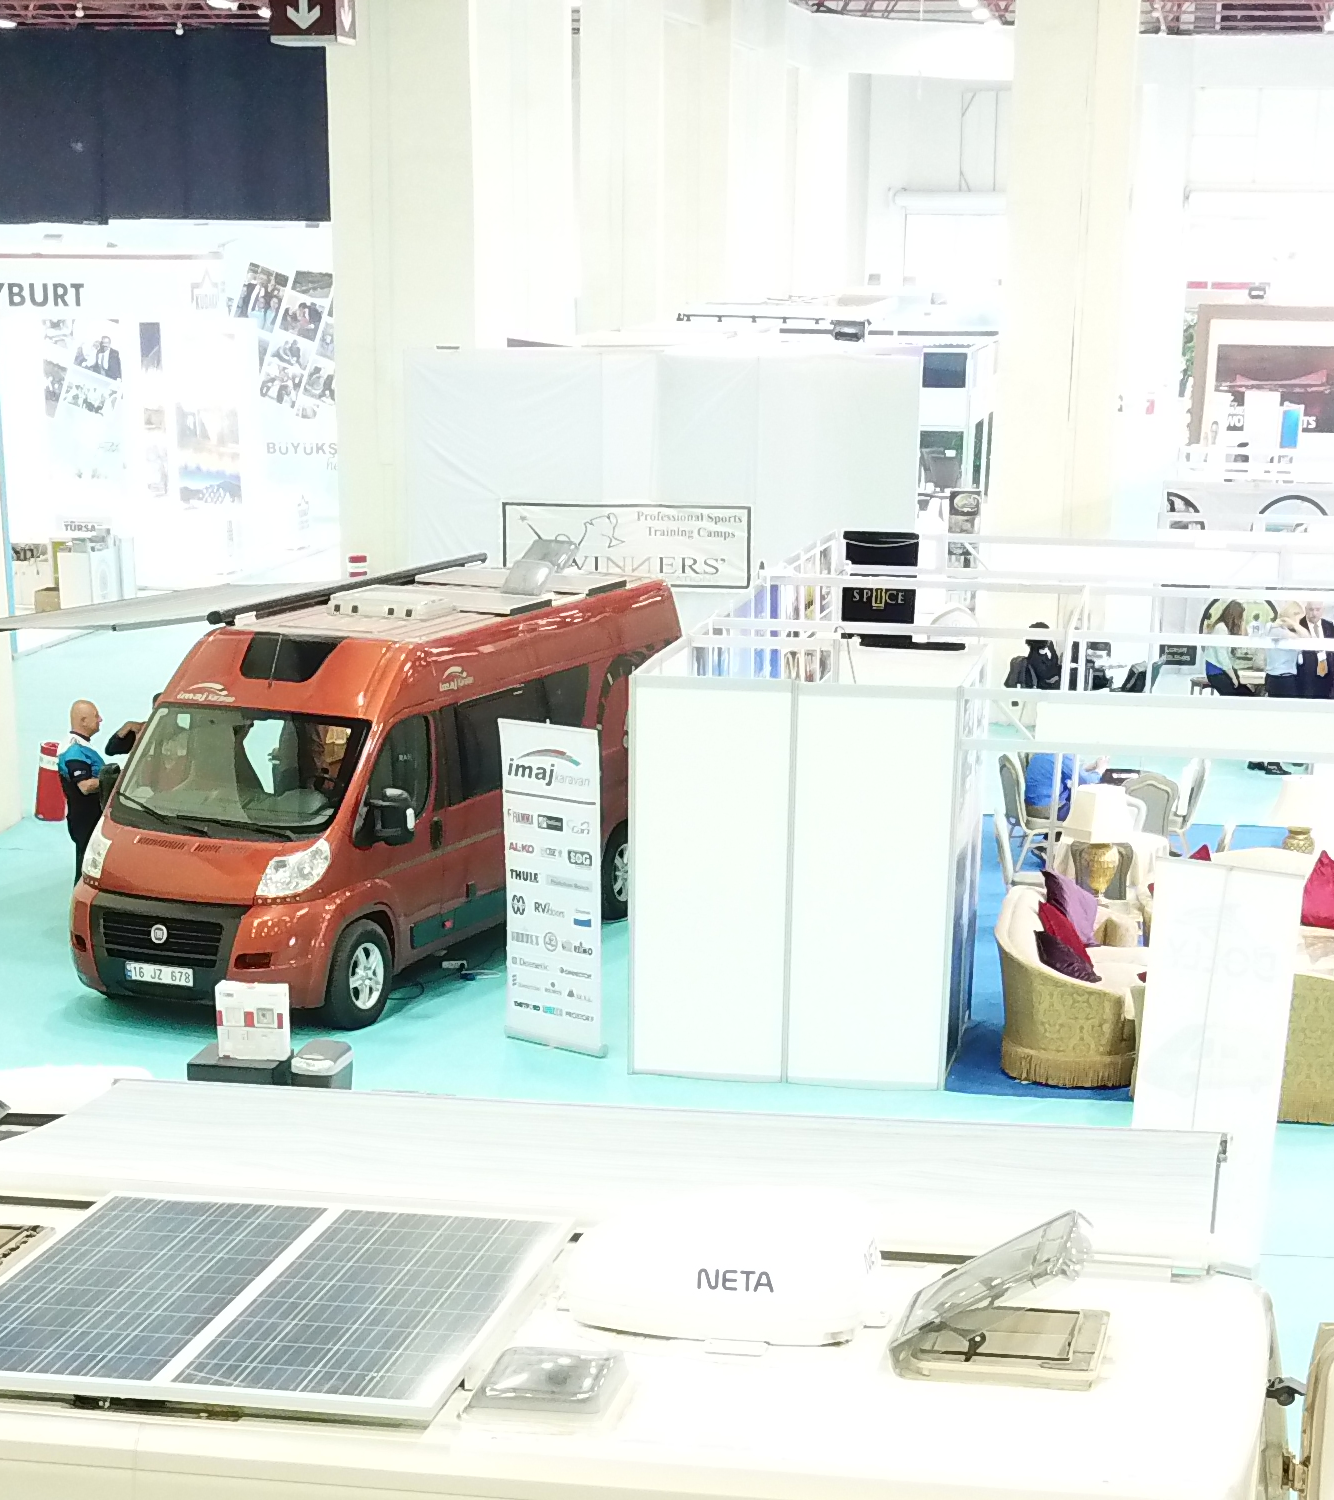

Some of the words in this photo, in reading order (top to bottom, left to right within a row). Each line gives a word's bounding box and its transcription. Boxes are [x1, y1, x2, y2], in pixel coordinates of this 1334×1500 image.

[636, 510, 704, 522] Professional
[706, 514, 743, 525] Sports
[63, 520, 99, 533] TÜRSA
[646, 526, 694, 540] Training
[697, 526, 736, 541] Camps
[508, 757, 555, 787] imaj
[509, 868, 540, 883] THULE
[132, 967, 145, 980] 16
[150, 969, 163, 981] JZ
[170, 970, 192, 984] 678
[695, 1268, 775, 1294] NETA
